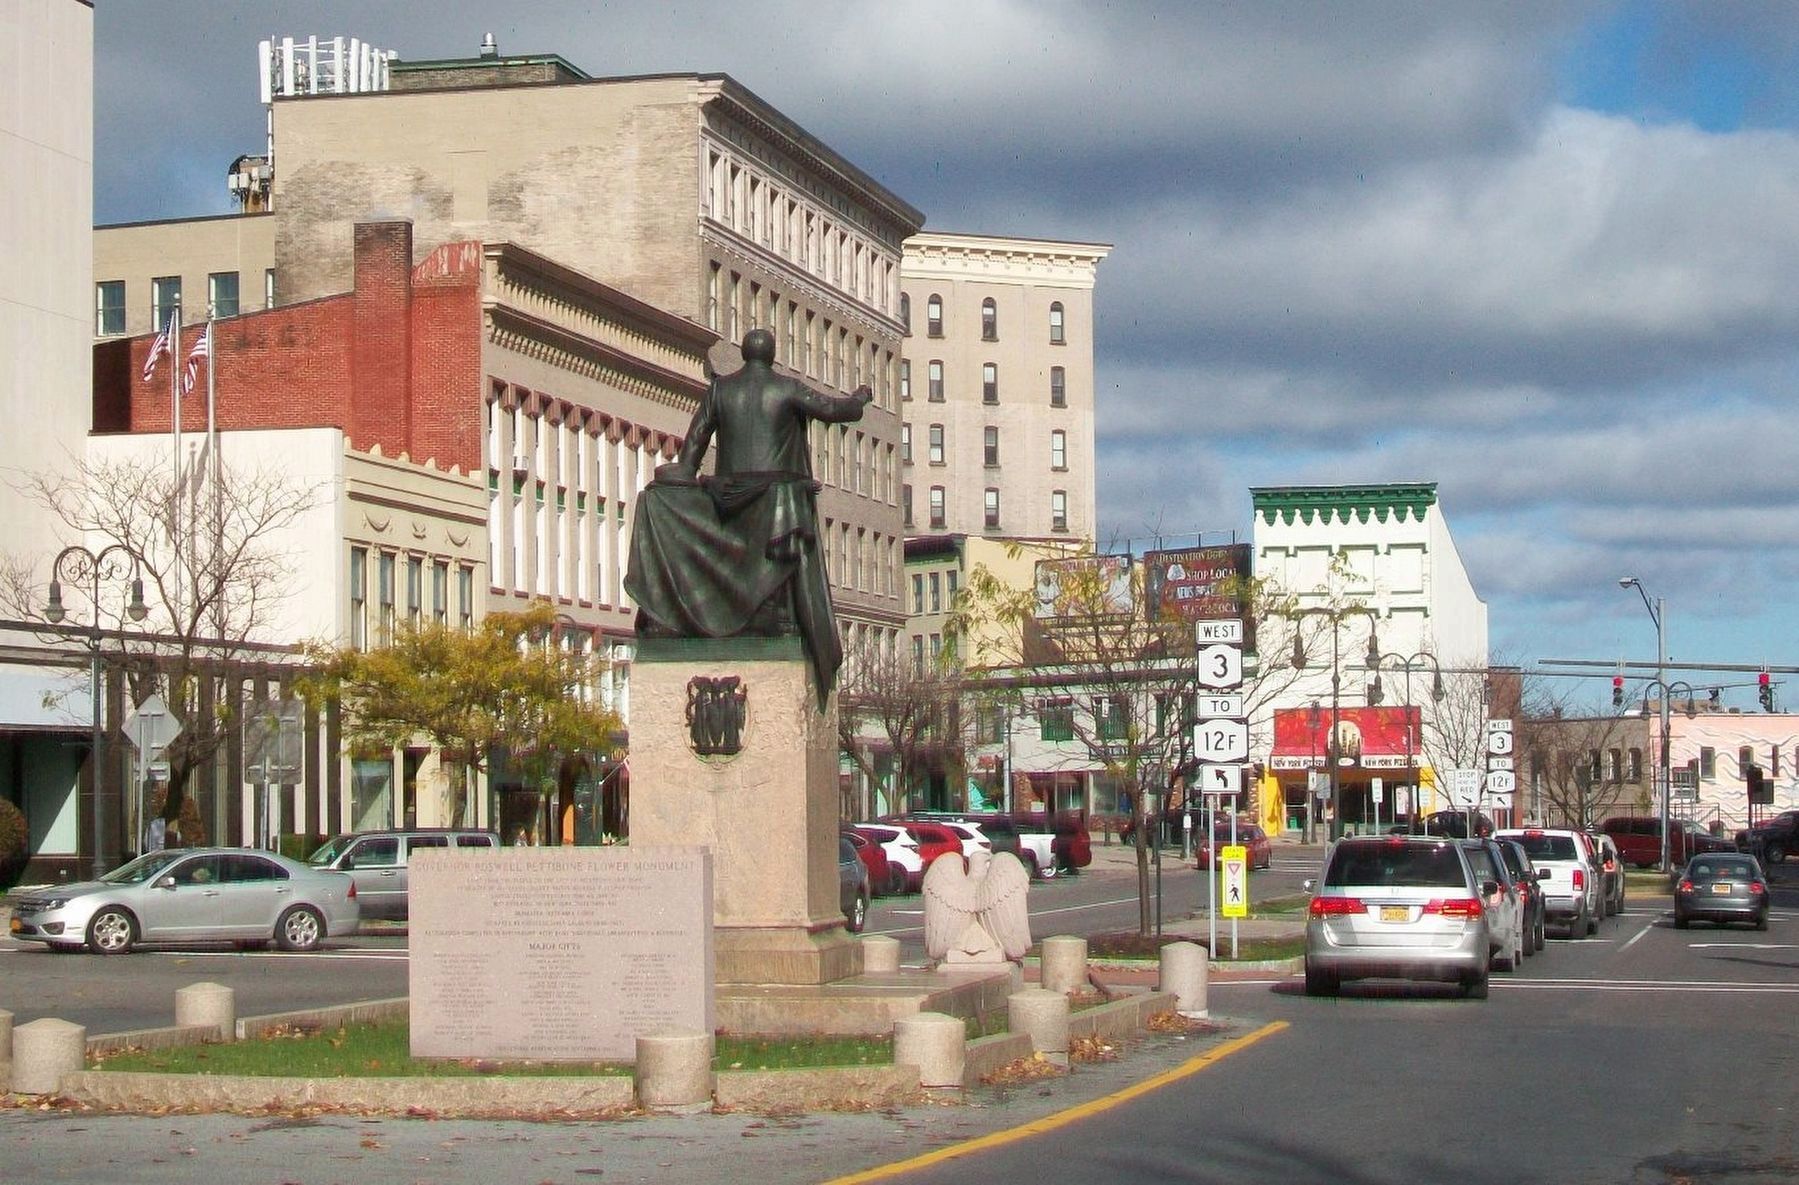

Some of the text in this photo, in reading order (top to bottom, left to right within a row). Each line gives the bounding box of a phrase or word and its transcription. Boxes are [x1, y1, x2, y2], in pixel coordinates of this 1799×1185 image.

[1186, 570, 1209, 581] SHOP
[1203, 625, 1236, 638] WEST
[1212, 654, 1228, 679] 3
[1210, 700, 1231, 712] TO
[1491, 721, 1509, 729] WEST
[1205, 731, 1237, 752] 12F
[1496, 736, 1505, 749] 3
[1288, 759, 1302, 768] YORK
[1364, 758, 1377, 767] NEW
[1378, 758, 1392, 767] YORK
[1496, 760, 1507, 768] TO
[1459, 771, 1476, 779] STOP
[1492, 775, 1510, 788] 12F
[474, 862, 522, 872] ROSWELL
[526, 861, 582, 872] PETTIBONE
[587, 861, 629, 872] FLOWER
[636, 861, 694, 872] MONUMENT
[528, 942, 556, 951] MAJOR
